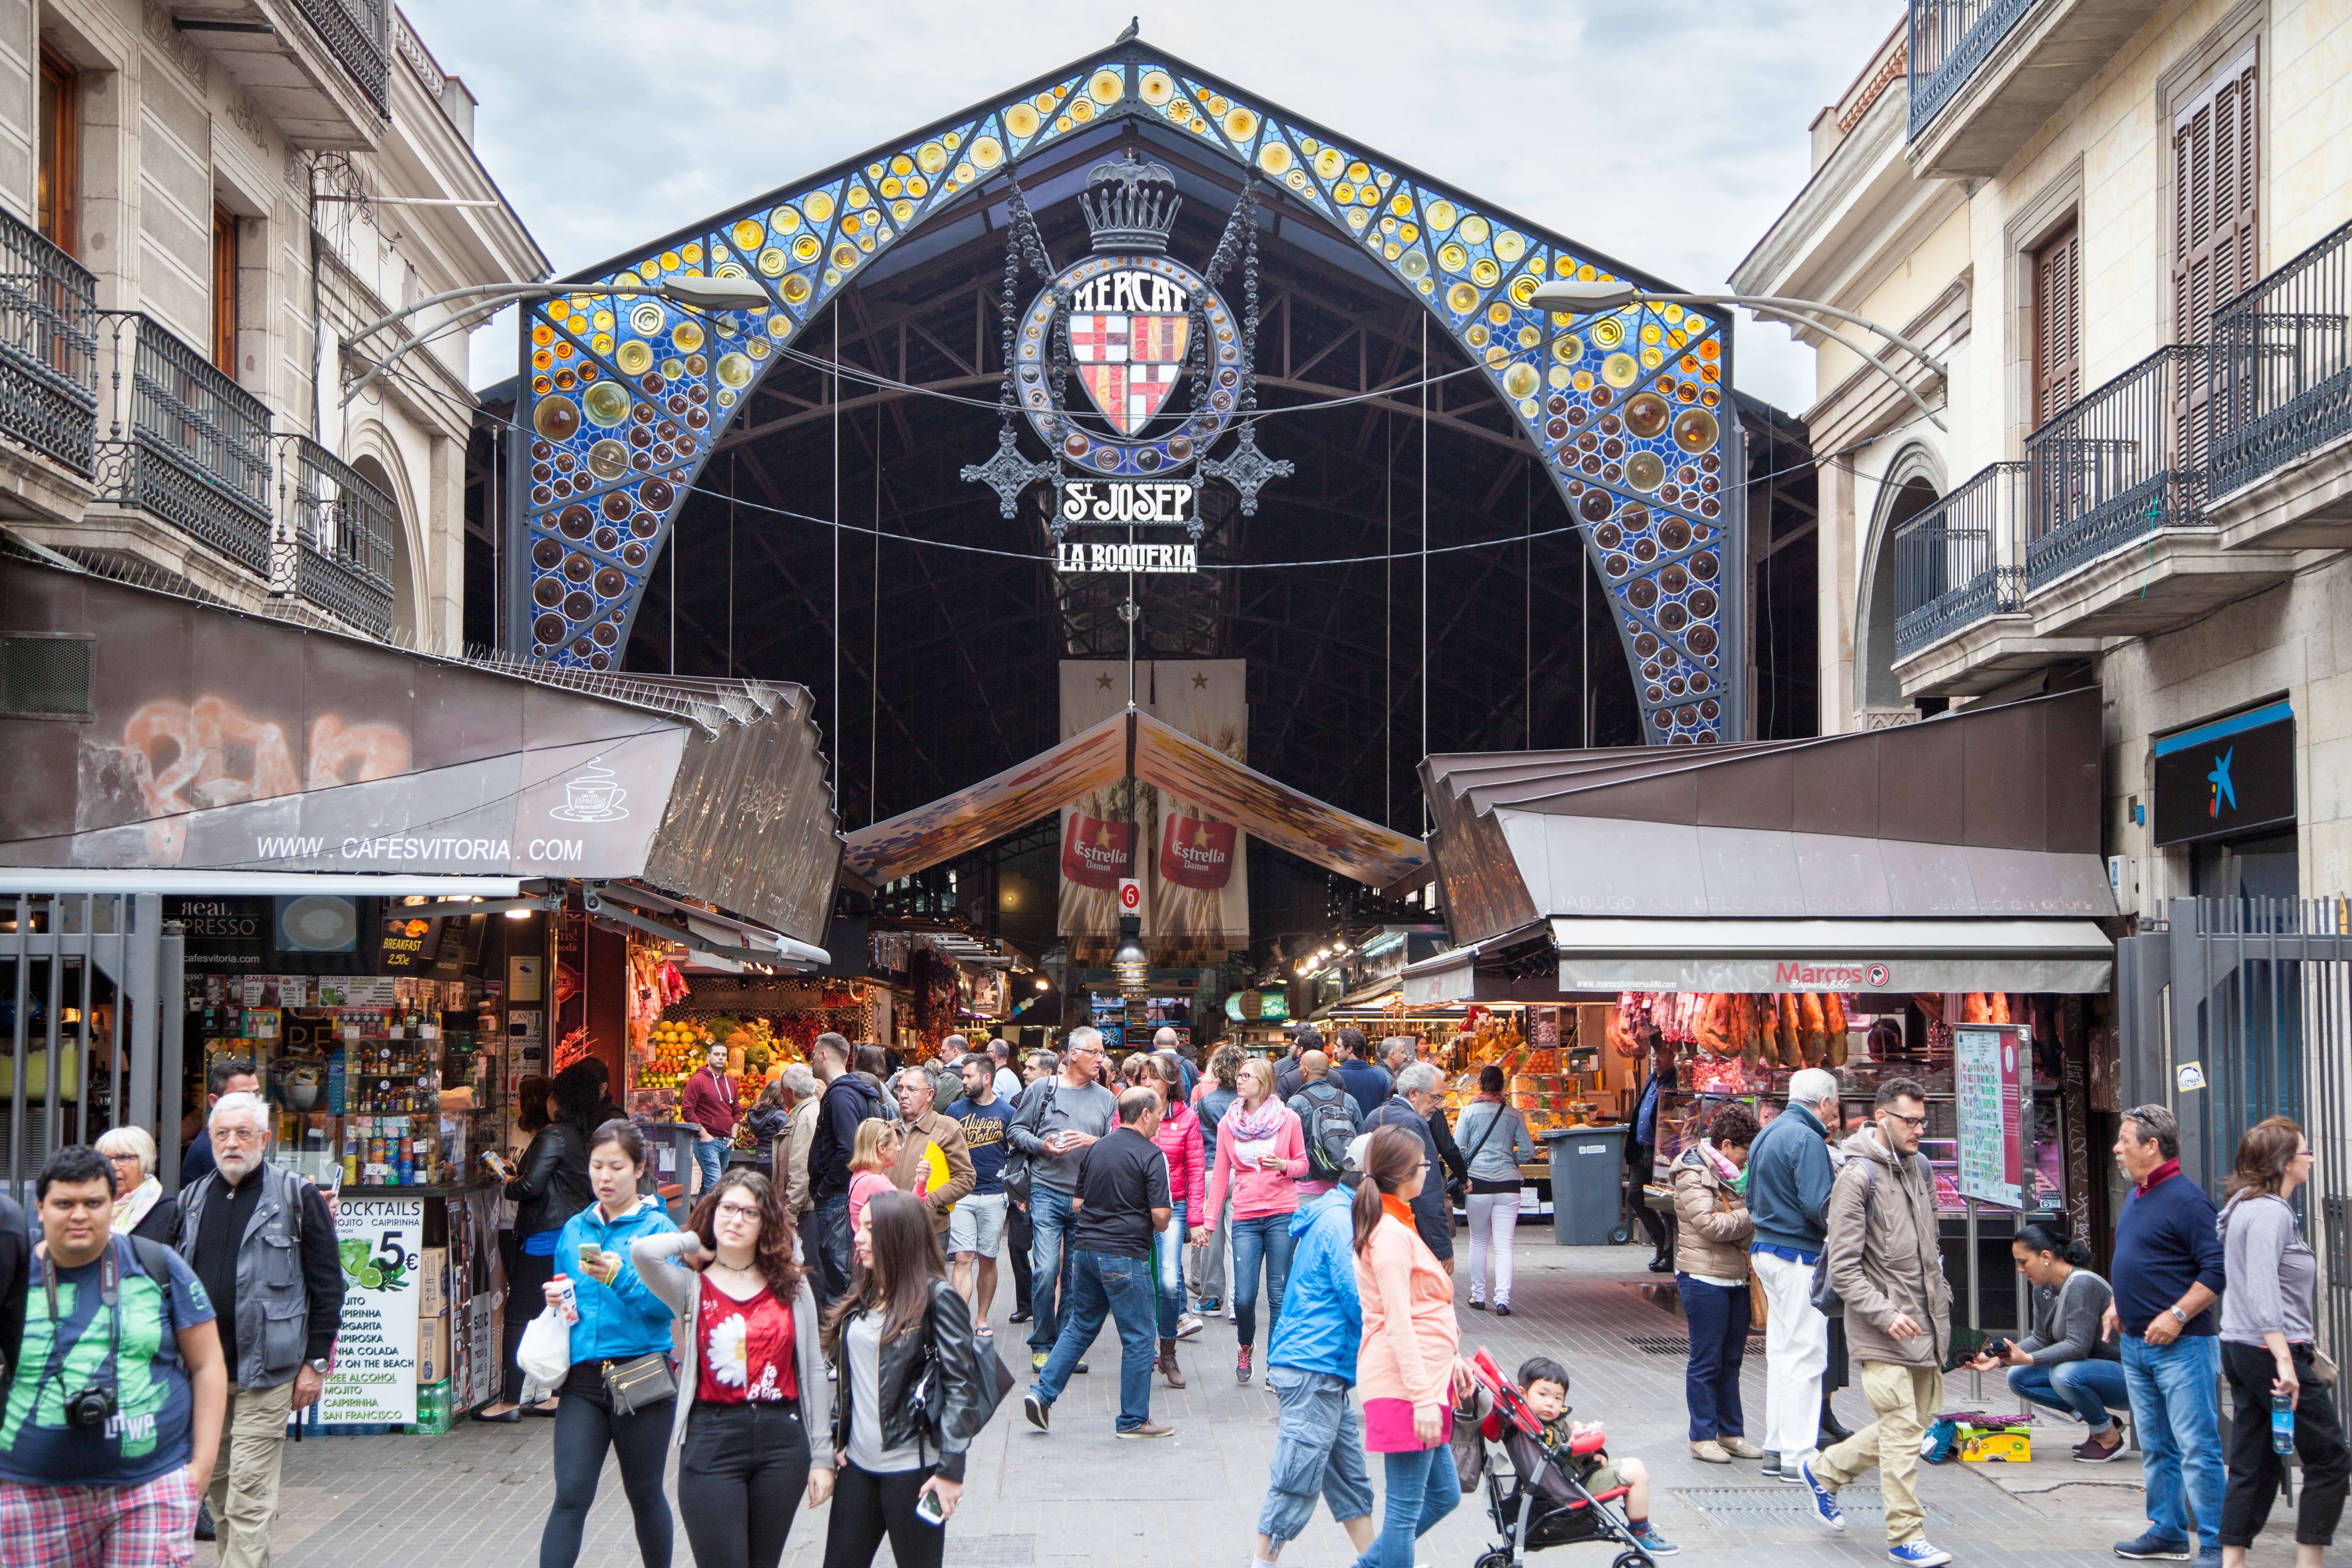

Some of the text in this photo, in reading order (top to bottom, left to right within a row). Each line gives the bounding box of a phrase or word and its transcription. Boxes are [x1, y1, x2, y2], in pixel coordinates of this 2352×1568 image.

[1074, 271, 1186, 312] MERCAT
[1093, 483, 1192, 522] JOSEP
[1058, 543, 1197, 573] LA BOQUERIA
[1074, 840, 1127, 864] Estrella
[1171, 840, 1225, 864] Estrella
[1086, 859, 1111, 872] Damm
[1184, 859, 1209, 872] Damm
[1126, 887, 1135, 904] 6
[1557, 895, 1635, 910] JABUGO
[383, 938, 422, 952] BREAKFAST
[387, 954, 410, 965] 2,50€
[1776, 962, 1863, 984] Marcos
[510, 1011, 534, 1022] CAVA
[2179, 1076, 2202, 1086] ELEPHANT
[958, 1112, 1003, 1137] Hilfiger
[967, 1129, 1003, 1145] Denim
[336, 1202, 420, 1216] OCKTAILS
[106, 1261, 114, 1287] Canon
[342, 1310, 382, 1318] IPIRINHA
[357, 1347, 399, 1355] COLADA
[345, 1359, 414, 1368] ON THE BEACH
[325, 1373, 397, 1382] FREE ALCOHOL
[324, 1386, 362, 1395] MOJITO
[323, 1398, 379, 1407] CAIPIRINHA
[323, 1411, 402, 1420] SAN FRANCISCO
